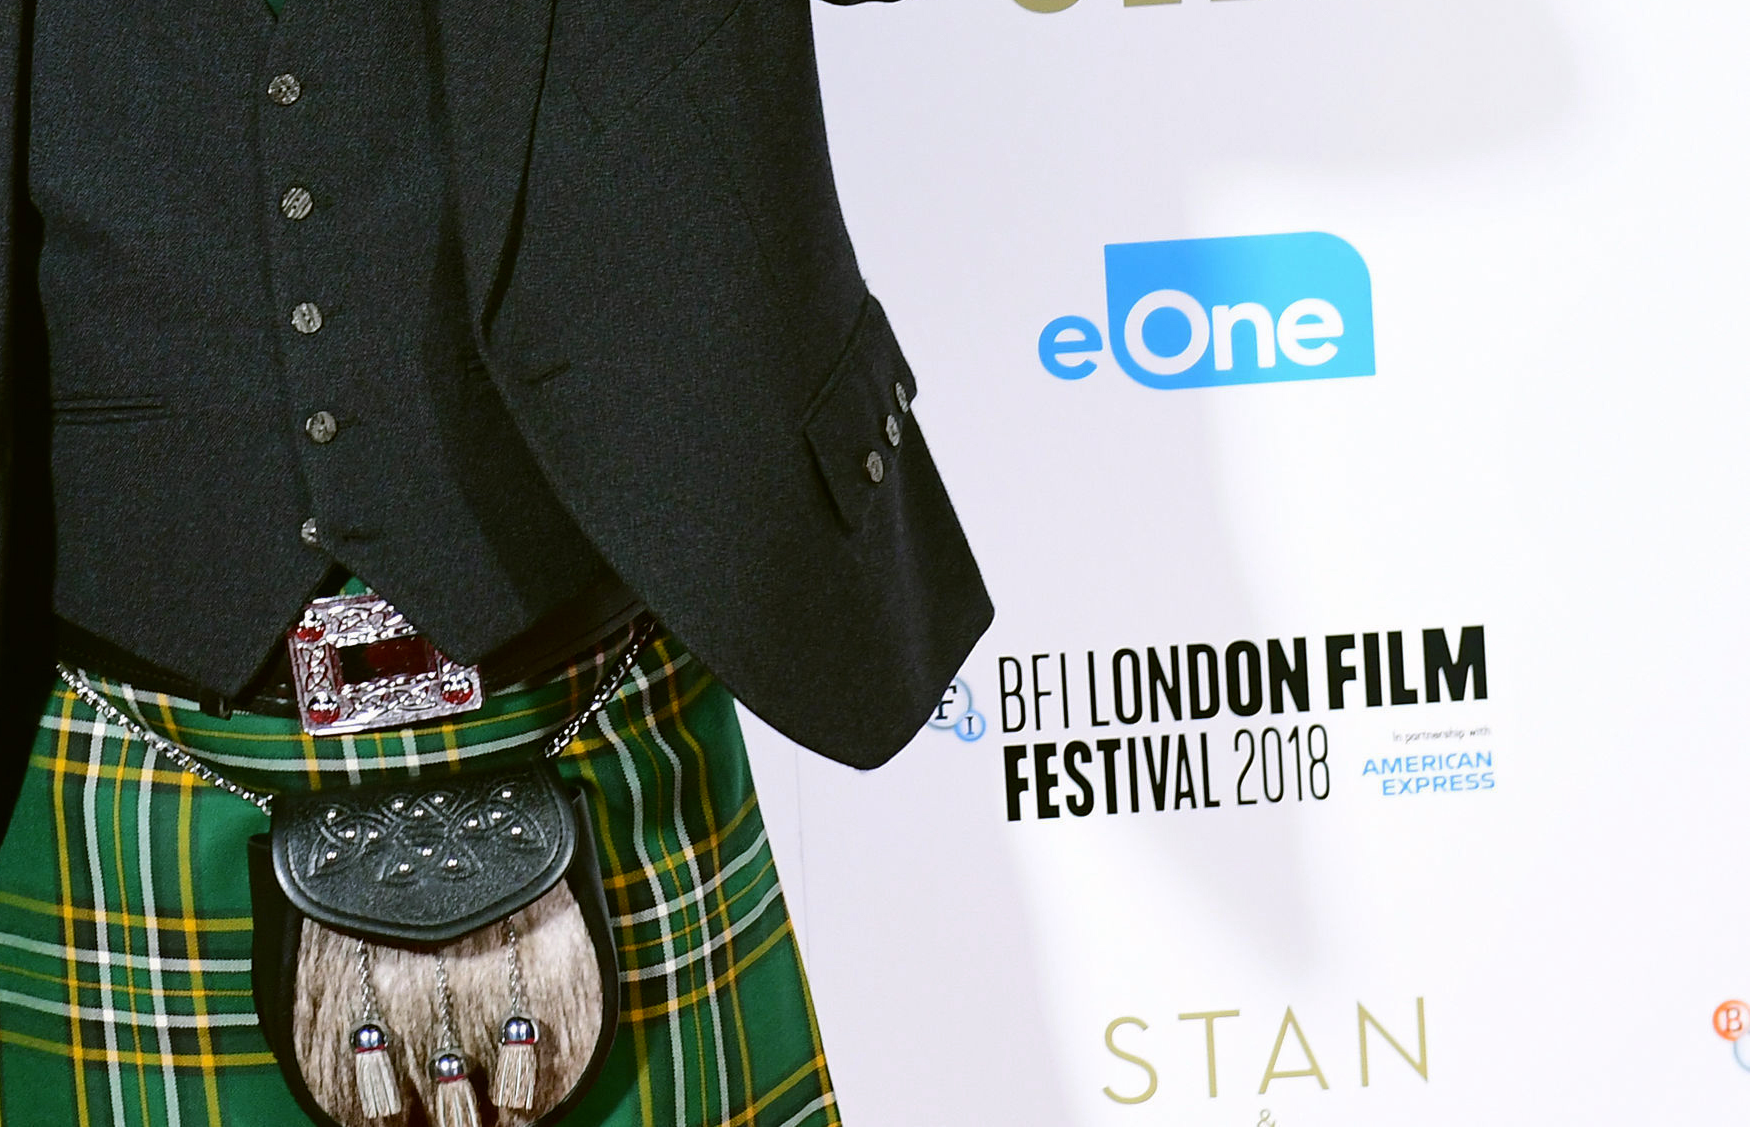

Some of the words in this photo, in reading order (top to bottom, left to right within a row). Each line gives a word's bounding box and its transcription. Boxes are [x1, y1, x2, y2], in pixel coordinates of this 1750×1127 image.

[1038, 289, 1344, 381] eOne
[998, 652, 1070, 734] BFI
[1087, 637, 1313, 727] LONDON
[1326, 624, 1489, 711] FILM
[1003, 730, 1221, 823] FESTIVAL
[1234, 723, 1331, 806] 2018
[1361, 750, 1493, 777] AMERICAN
[1405, 727, 1466, 745] partnership
[1469, 725, 1492, 737] with
[1381, 772, 1496, 797] EXPRESS
[1103, 996, 1429, 1105] STAN
